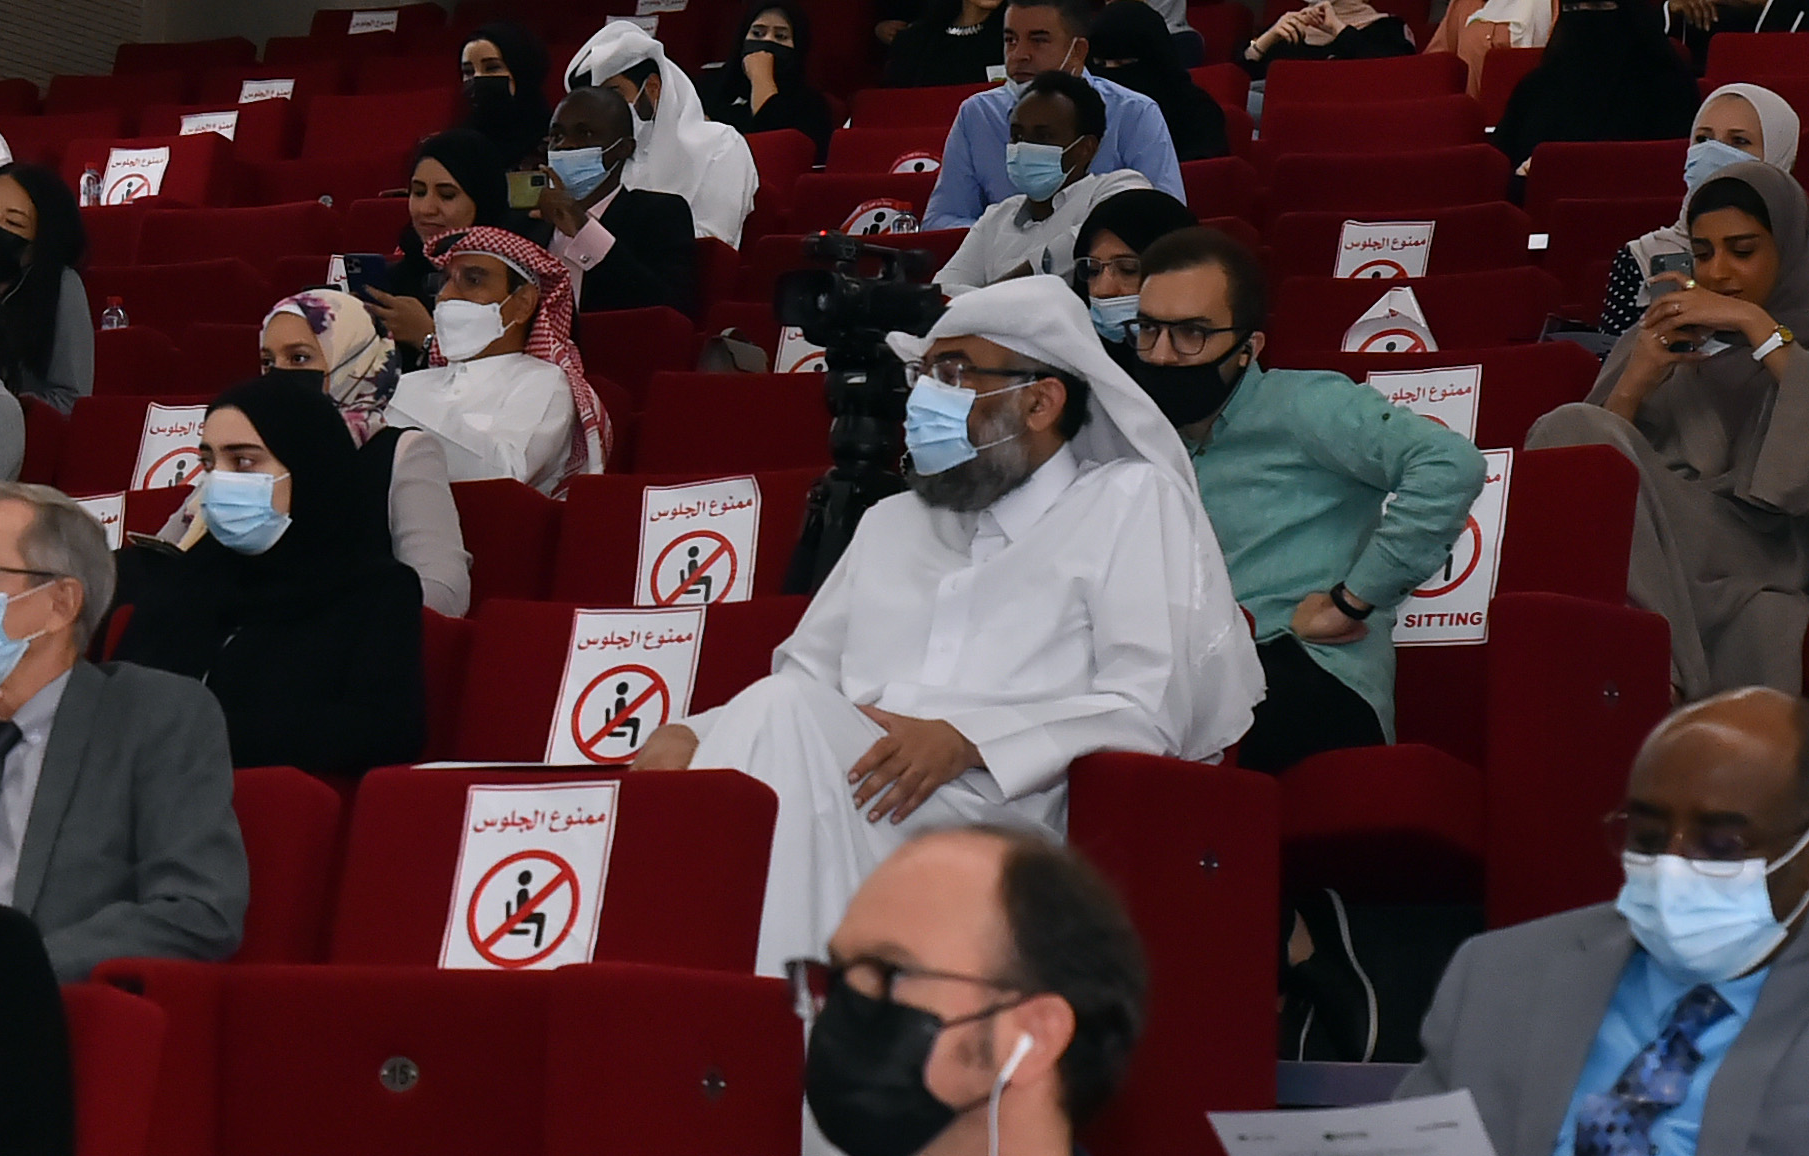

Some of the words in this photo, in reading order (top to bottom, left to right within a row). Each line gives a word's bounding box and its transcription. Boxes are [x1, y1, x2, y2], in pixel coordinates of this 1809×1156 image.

[1343, 237, 1390, 252] الجلوس
[1390, 235, 1427, 251] ممنوع
[1386, 387, 1427, 405] الجلو
[1428, 383, 1473, 404] ممنوع
[149, 421, 196, 438] الجلوس
[649, 500, 706, 522] الجلوس
[708, 495, 753, 517] ممنوع
[100, 511, 119, 525] ممن
[1404, 611, 1484, 629] SITTING
[577, 630, 641, 651] الجلوس
[642, 627, 694, 651] ممنوع
[473, 809, 545, 834] الجلوس
[548, 806, 607, 834] ممنوع
